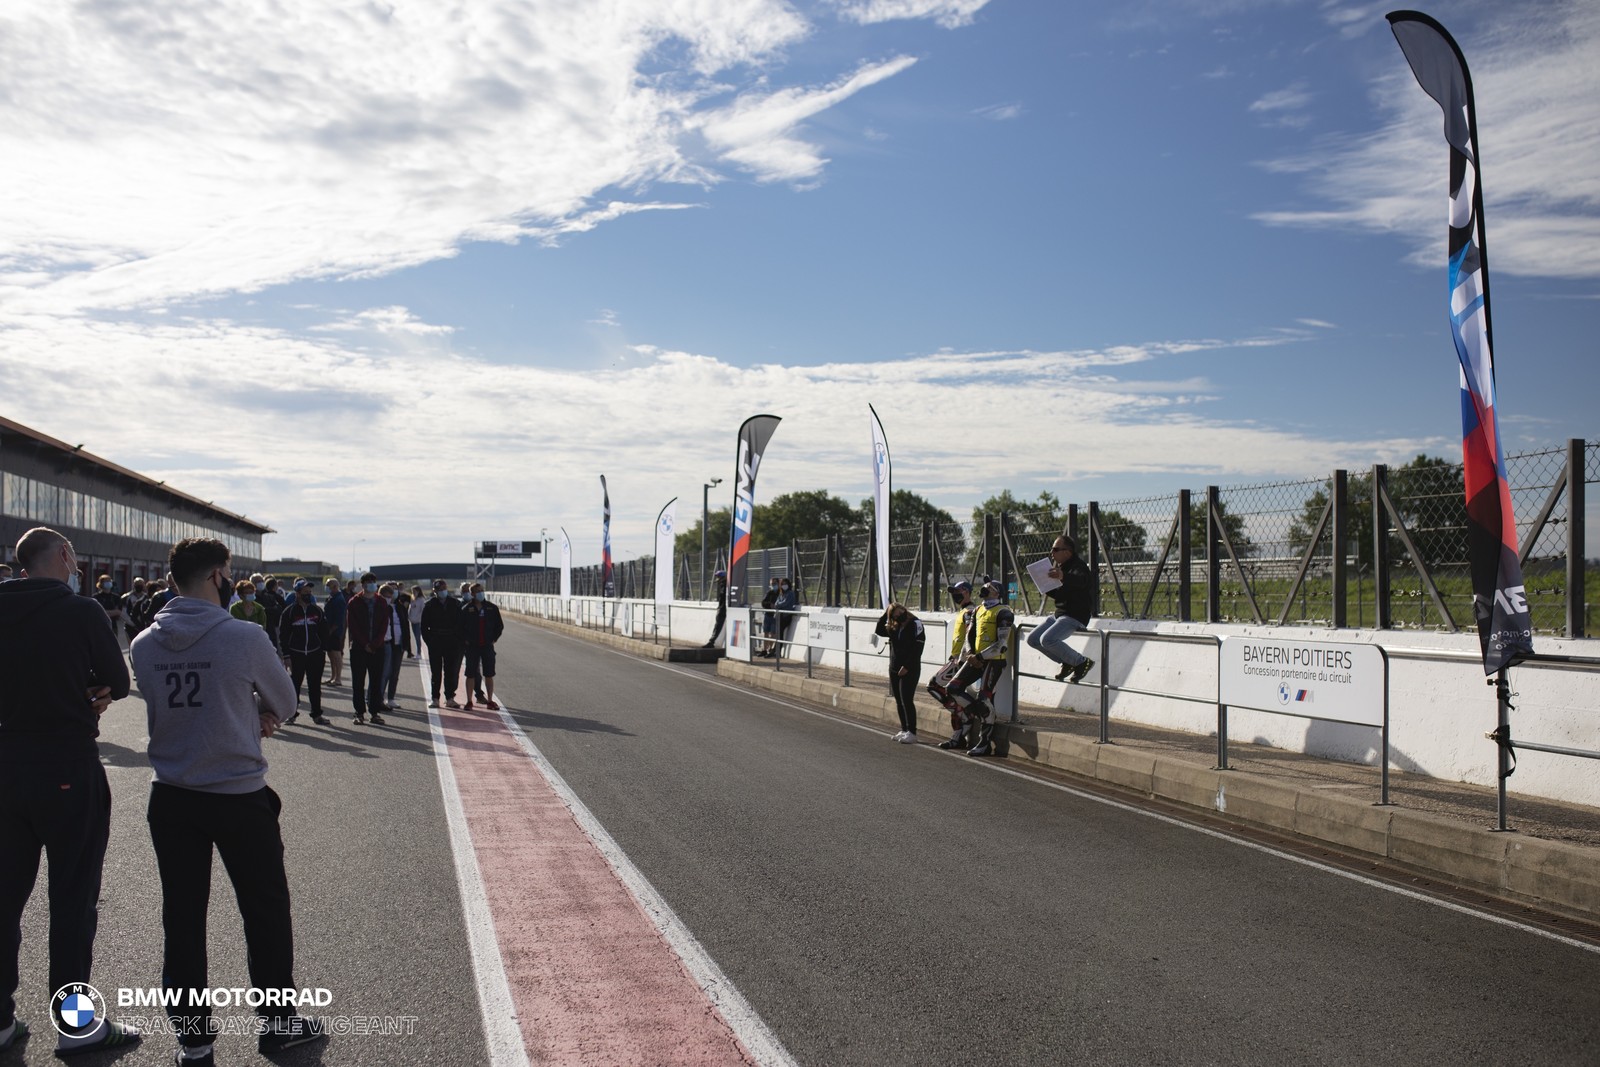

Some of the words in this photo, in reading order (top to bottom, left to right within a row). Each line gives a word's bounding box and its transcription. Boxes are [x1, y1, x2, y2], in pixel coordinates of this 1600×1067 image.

[154, 663, 169, 671] TEAM
[1243, 645, 1290, 665] BAYERN
[1293, 648, 1353, 670] POITIERS
[1243, 664, 1280, 677] Concession
[1281, 669, 1317, 681] partenaire
[1318, 671, 1328, 681] du
[1329, 672, 1352, 684] circuit
[165, 671, 203, 708] 22
